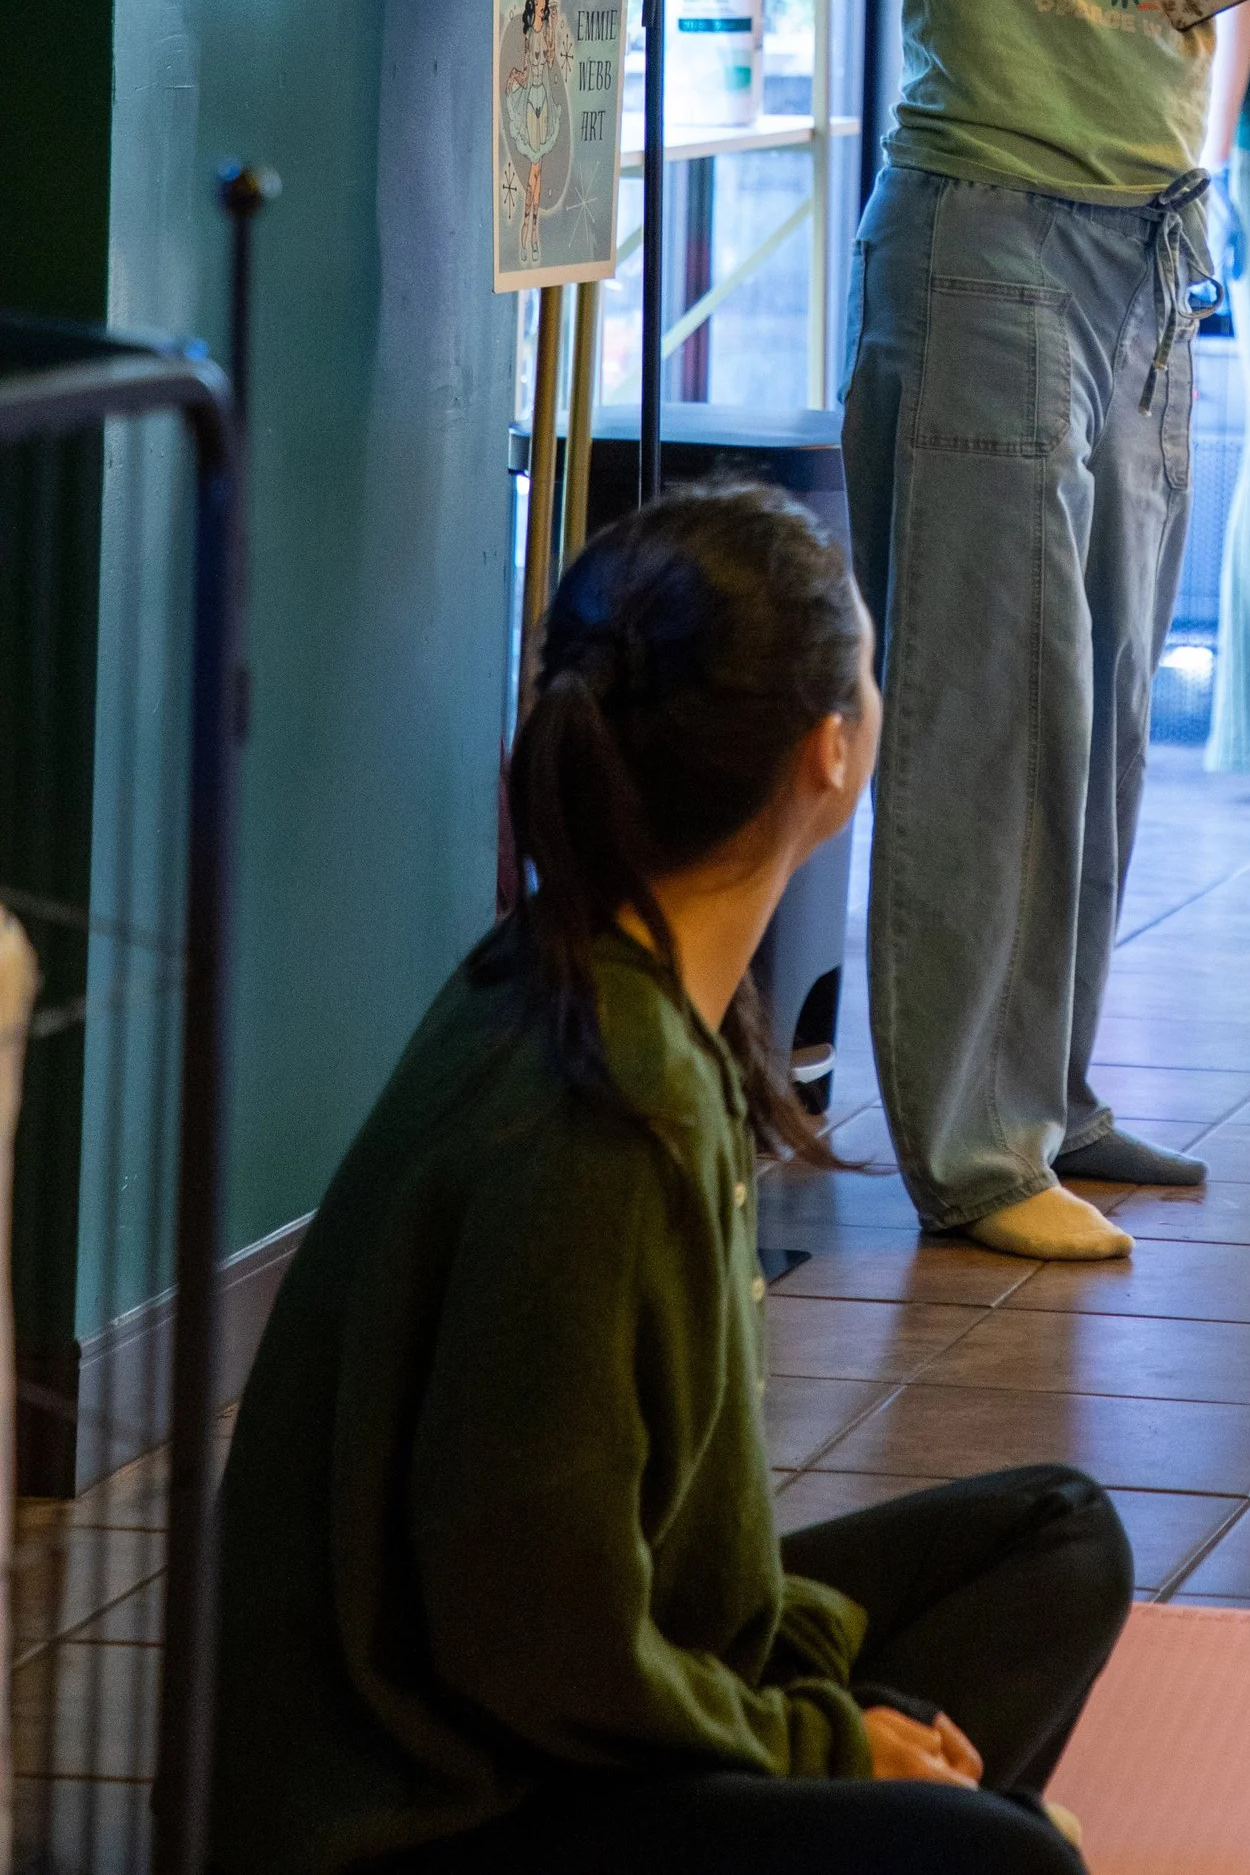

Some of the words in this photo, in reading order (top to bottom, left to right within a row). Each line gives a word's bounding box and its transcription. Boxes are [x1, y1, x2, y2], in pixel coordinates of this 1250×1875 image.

[577, 9, 618, 42] EMMIE
[579, 56, 612, 92] WEBB
[580, 110, 607, 142] ART
